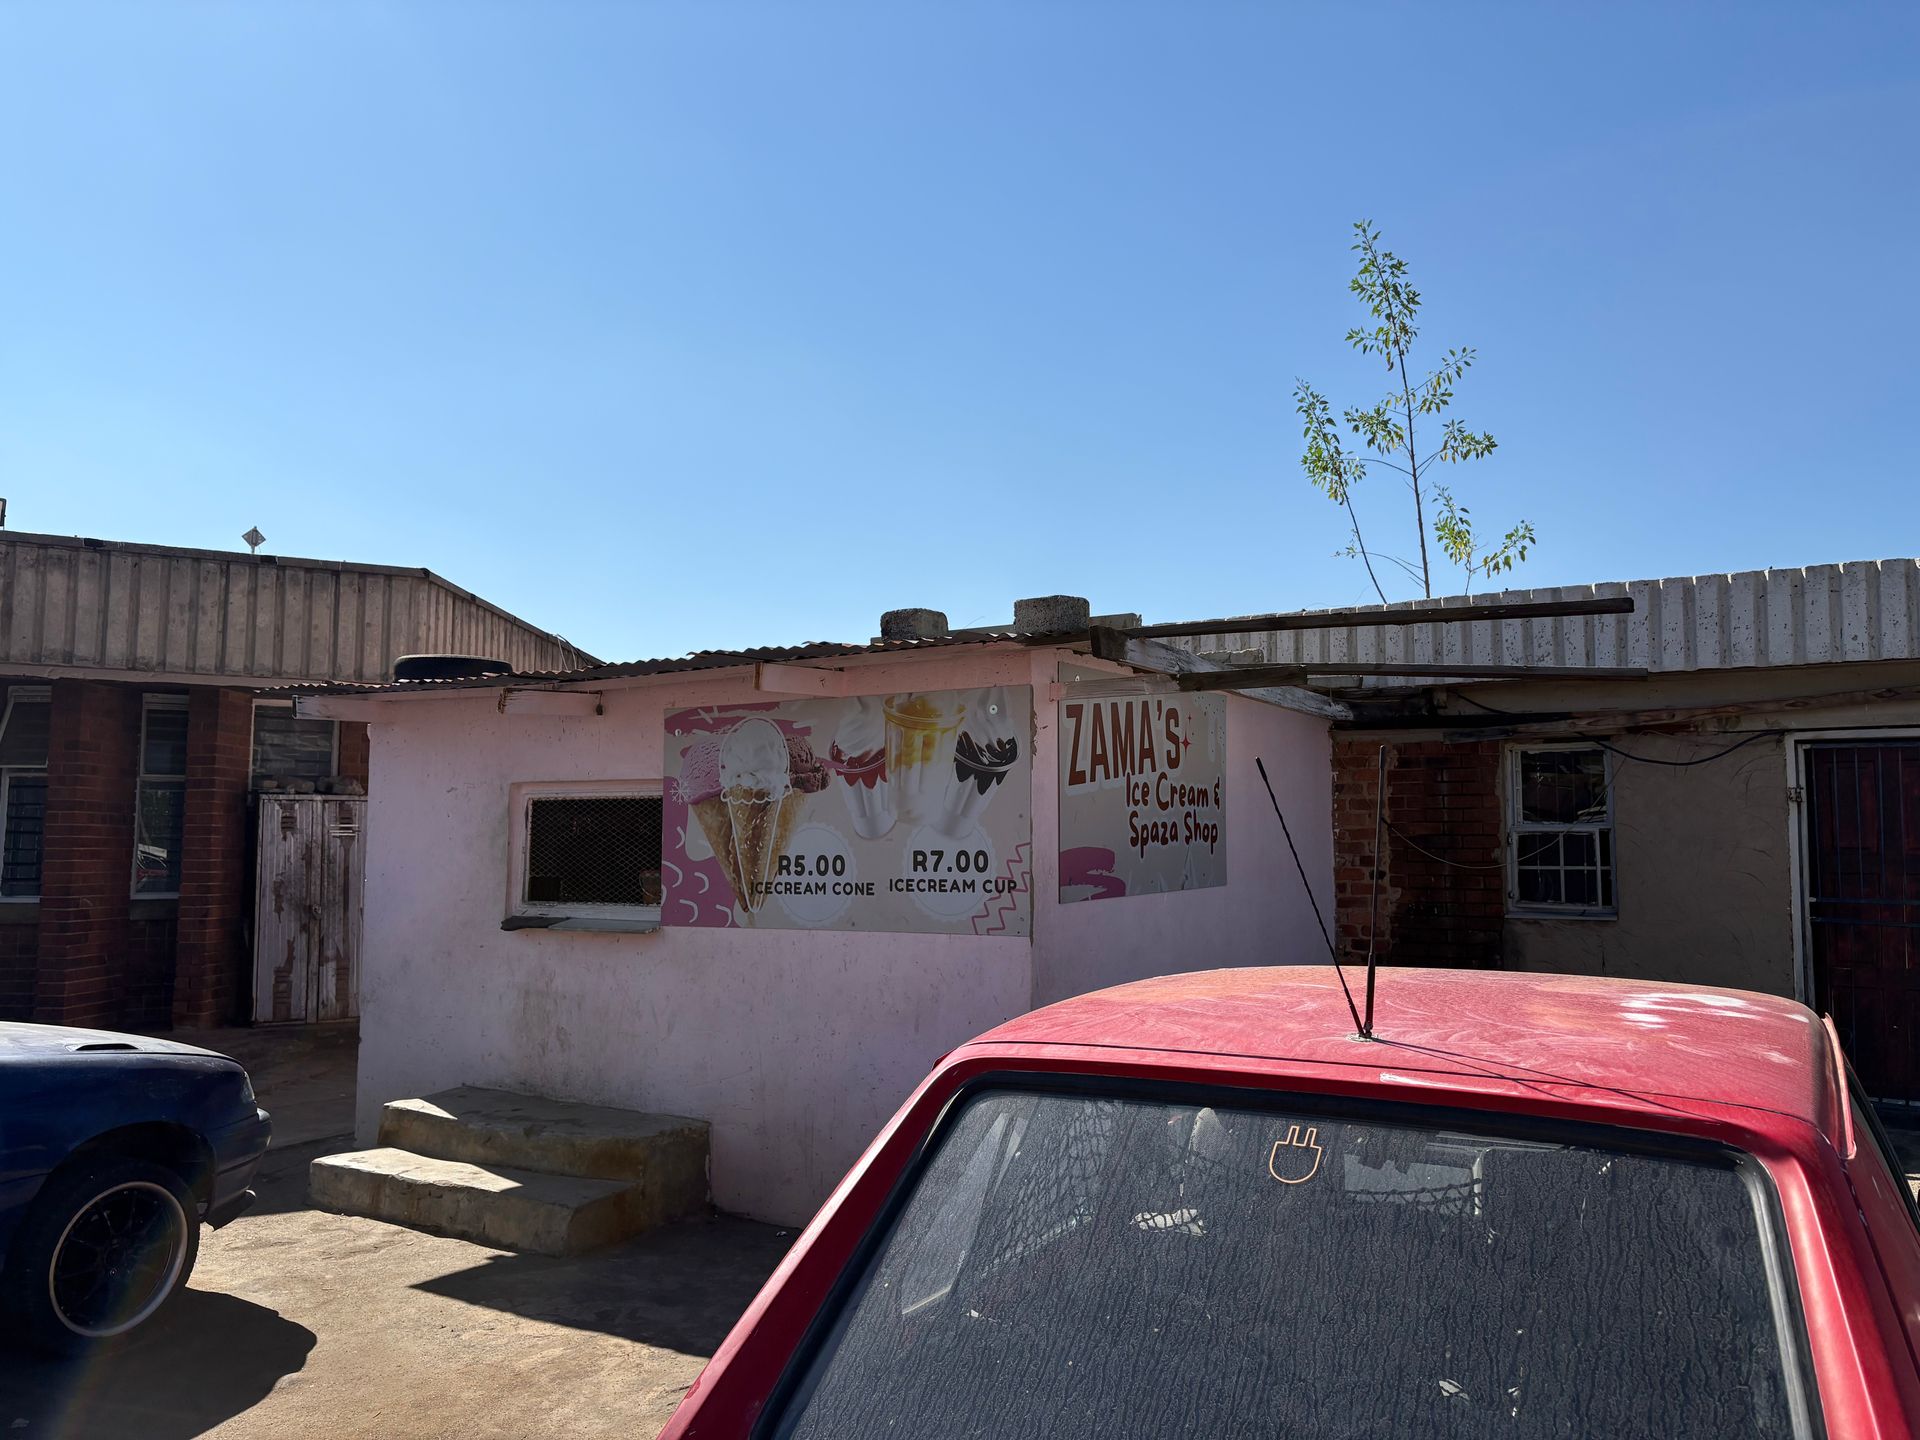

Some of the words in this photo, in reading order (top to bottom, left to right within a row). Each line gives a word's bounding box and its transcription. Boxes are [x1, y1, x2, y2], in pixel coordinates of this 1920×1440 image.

[1126, 772, 1150, 807] Ice
[1155, 771, 1209, 811] Cream
[1129, 810, 1178, 859] Spaza
[1183, 809, 1218, 855] Shop
[777, 854, 846, 877] R5.00
[912, 849, 989, 873] R7.00
[750, 881, 827, 896] ICECREAM
[832, 882, 875, 896] CONE
[889, 878, 976, 894] ICECREAM
[982, 878, 1018, 895] CUP
